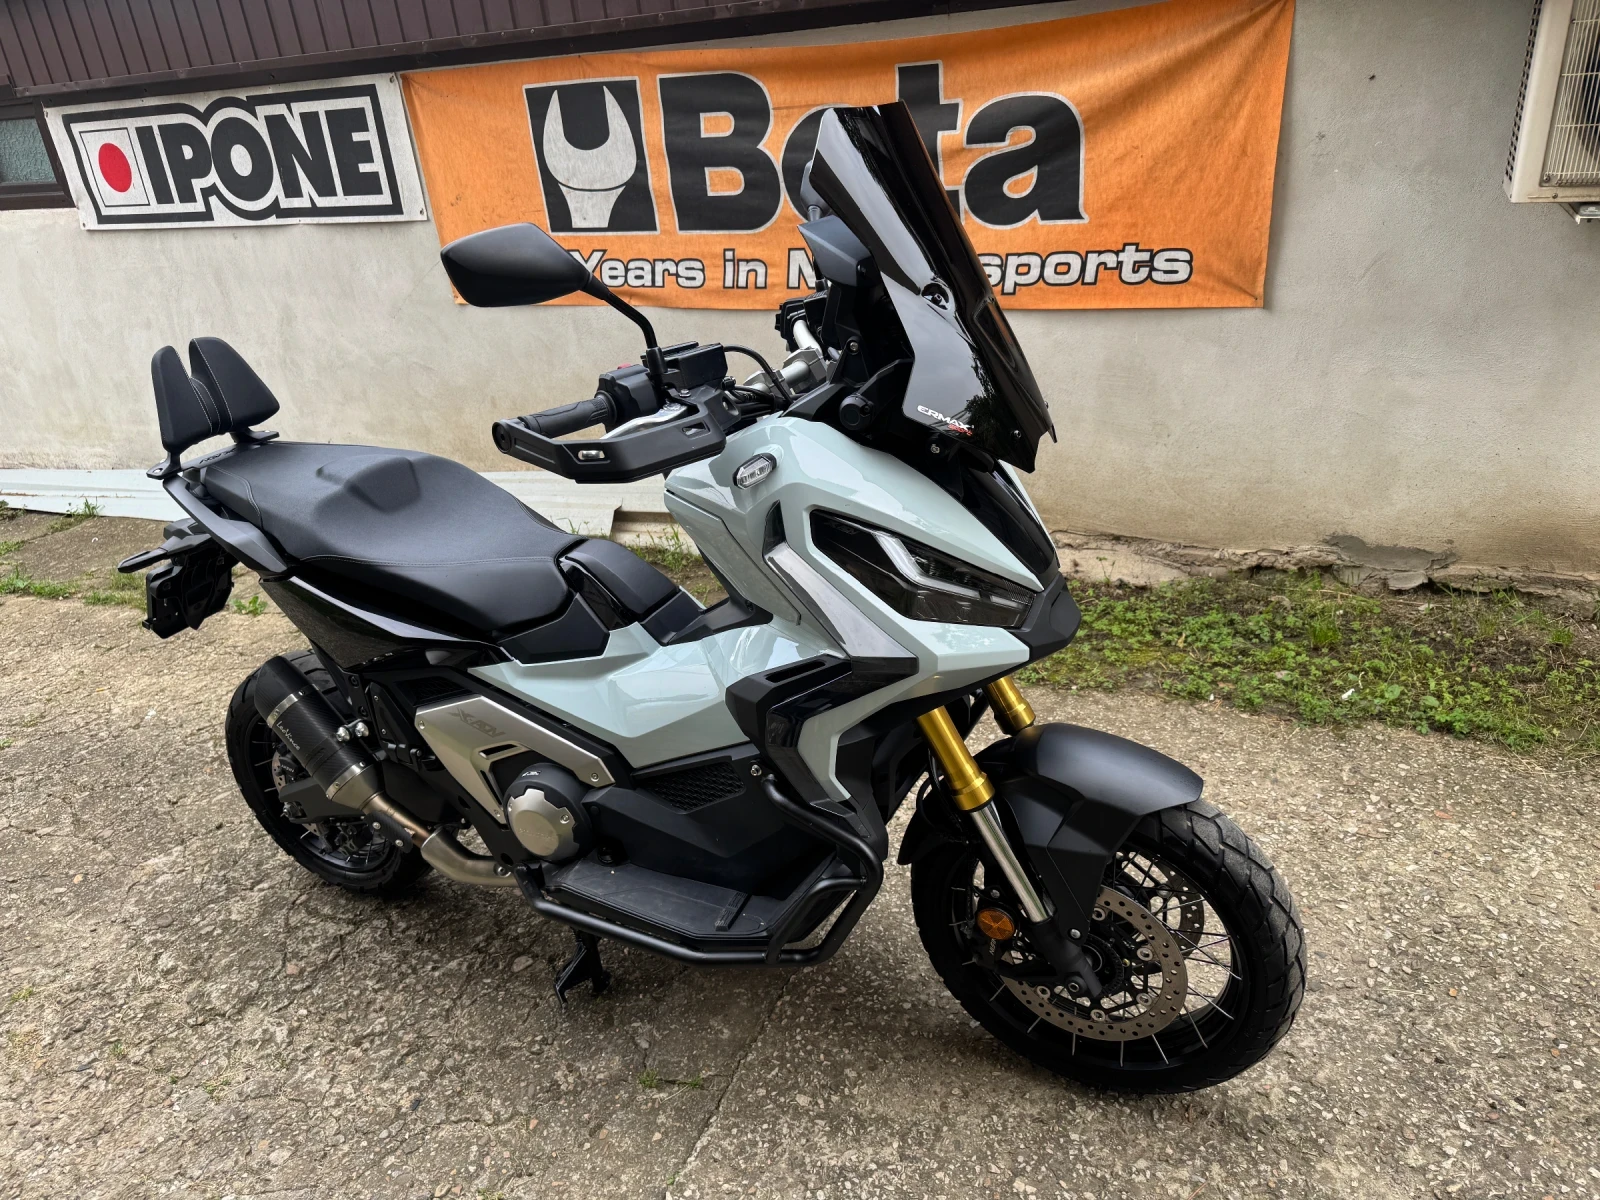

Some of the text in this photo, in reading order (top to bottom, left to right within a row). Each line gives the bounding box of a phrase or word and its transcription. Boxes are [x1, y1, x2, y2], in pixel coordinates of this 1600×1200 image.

[135, 107, 385, 206] IPONE
[722, 248, 768, 290] in
[917, 405, 971, 431] ERMAX
